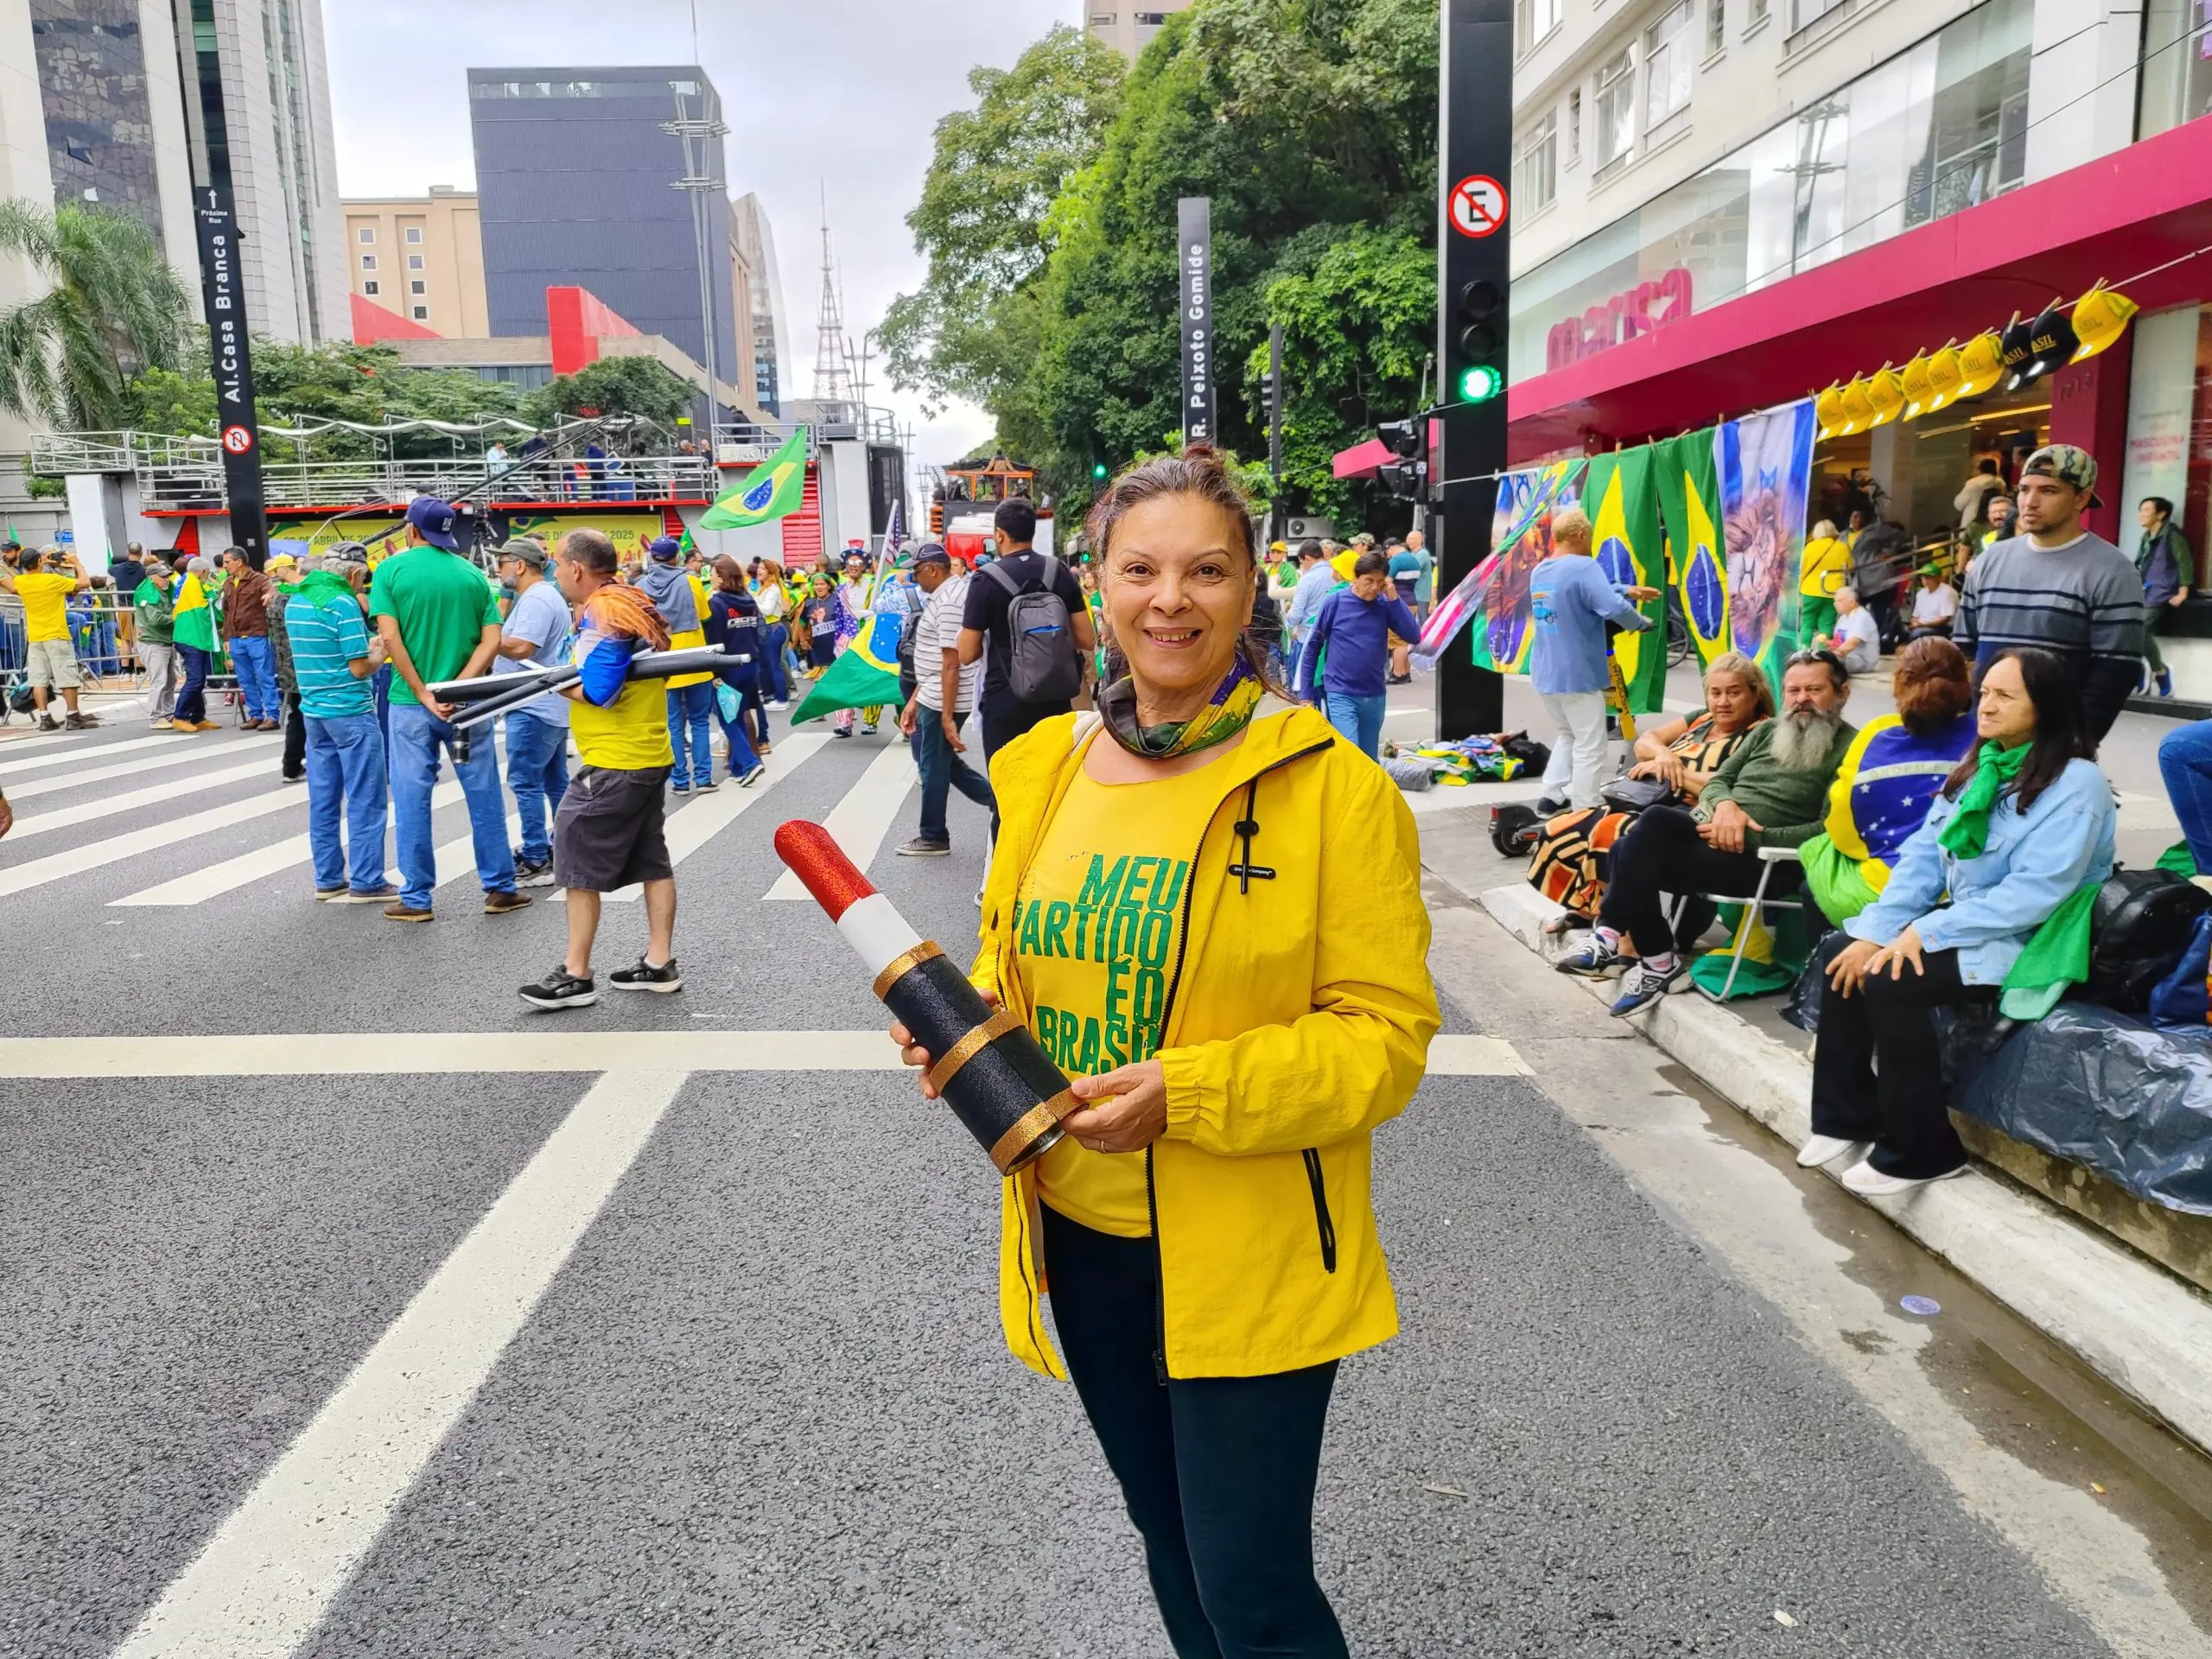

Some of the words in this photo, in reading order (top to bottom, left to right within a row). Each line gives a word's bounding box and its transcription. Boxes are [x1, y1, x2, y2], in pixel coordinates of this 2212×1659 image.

[213, 235, 232, 309] Branca
[1187, 244, 1205, 321] Gomide
[2005, 347, 2028, 363] ASIL
[2031, 334, 2056, 351] ASIL
[1190, 329, 1206, 408] Peixoto
[1191, 417, 1206, 437] R.
[610, 530, 635, 540] 2025
[1078, 853, 1190, 913] MEU
